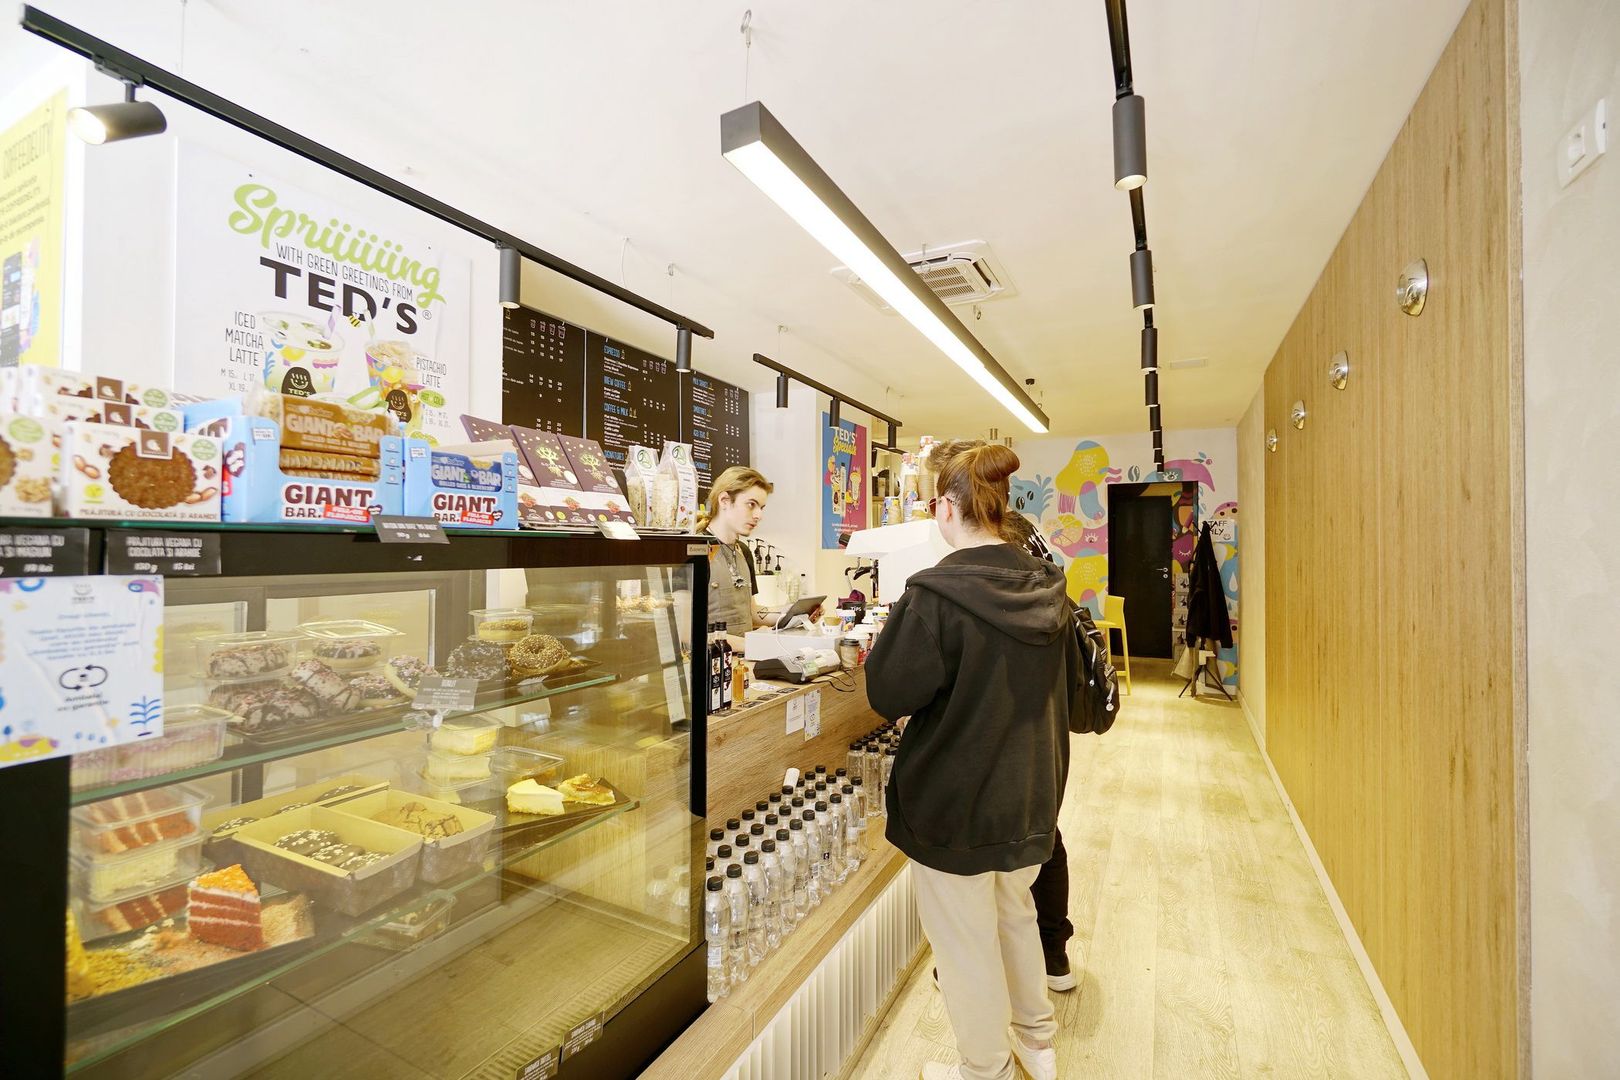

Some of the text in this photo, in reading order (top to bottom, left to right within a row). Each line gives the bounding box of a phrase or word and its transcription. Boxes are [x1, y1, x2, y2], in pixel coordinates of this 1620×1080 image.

[276, 242, 413, 301] WITH GREEN GREETINGS FROM
[260, 256, 418, 335] TED'S
[234, 311, 256, 330] ICED
[225, 328, 264, 351] MATCHA
[229, 347, 259, 367] LATTE
[422, 372, 441, 388] LATTE
[604, 402, 616, 414] COFFEE
[286, 413, 334, 438] GIANT
[352, 424, 384, 444] BAR
[432, 464, 501, 486] GIANT BAR
[284, 484, 372, 508] GIANT
[433, 494, 496, 513] GIANT
[285, 507, 322, 519] BAR.
